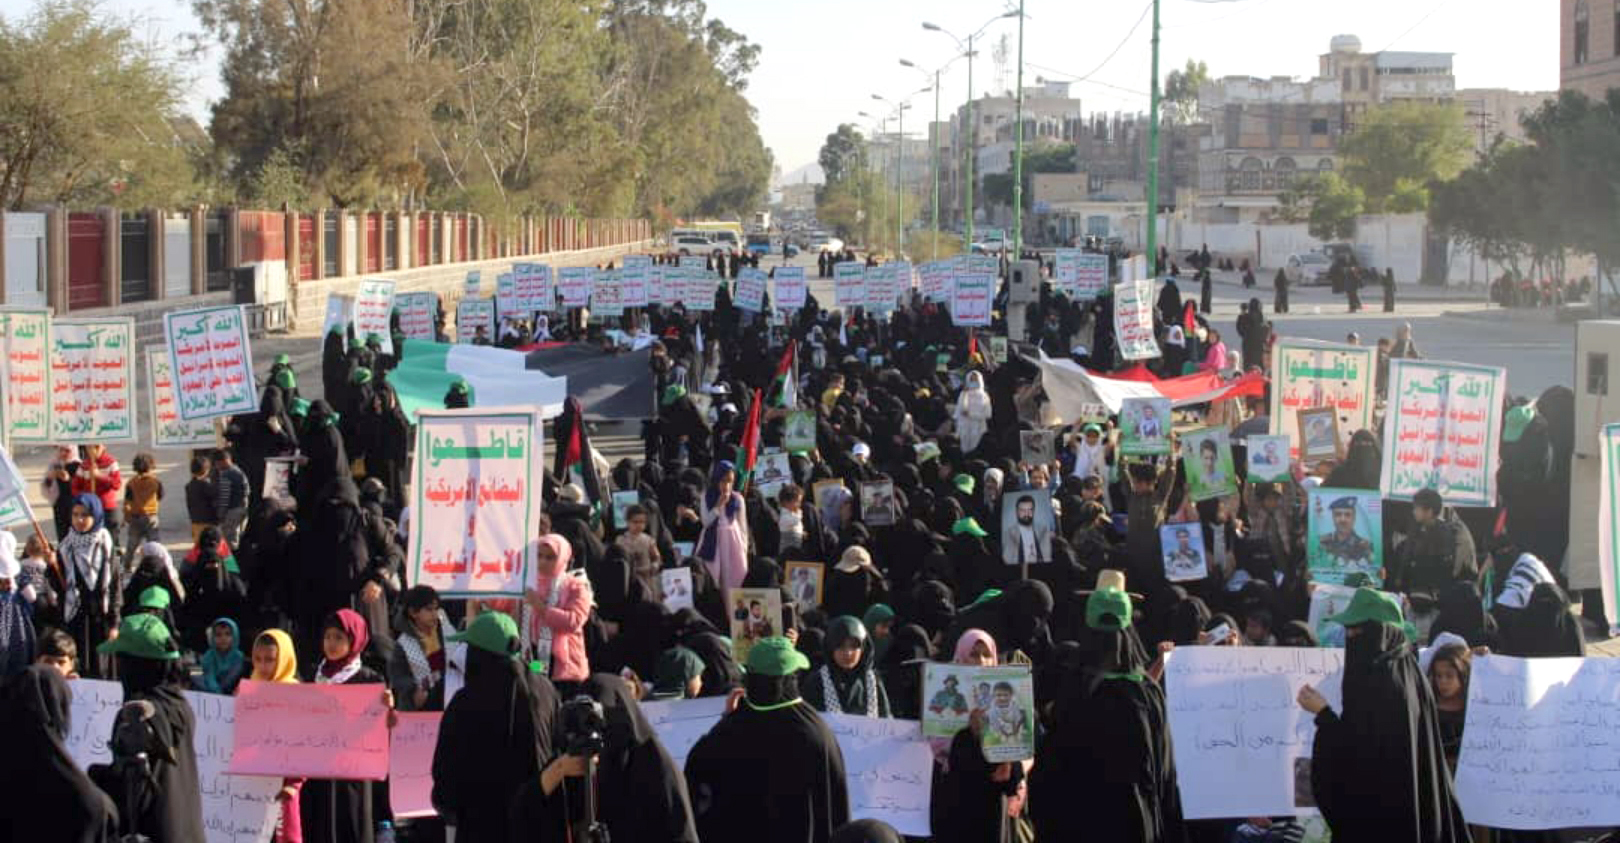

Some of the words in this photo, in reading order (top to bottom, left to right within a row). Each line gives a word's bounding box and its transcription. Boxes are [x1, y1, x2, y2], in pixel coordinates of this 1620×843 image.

[215, 314, 241, 331] الله
[105, 330, 126, 348] الله
[1286, 355, 1357, 383] قاطعوا
[1457, 376, 1489, 398] الله
[96, 416, 127, 435] النصر
[1449, 406, 1485, 423] الموت
[425, 429, 523, 467] قاطعوا
[1448, 429, 1484, 446] الموت
[478, 476, 523, 507] البضائع
[1441, 472, 1482, 495] النصر
[468, 514, 476, 537] و
